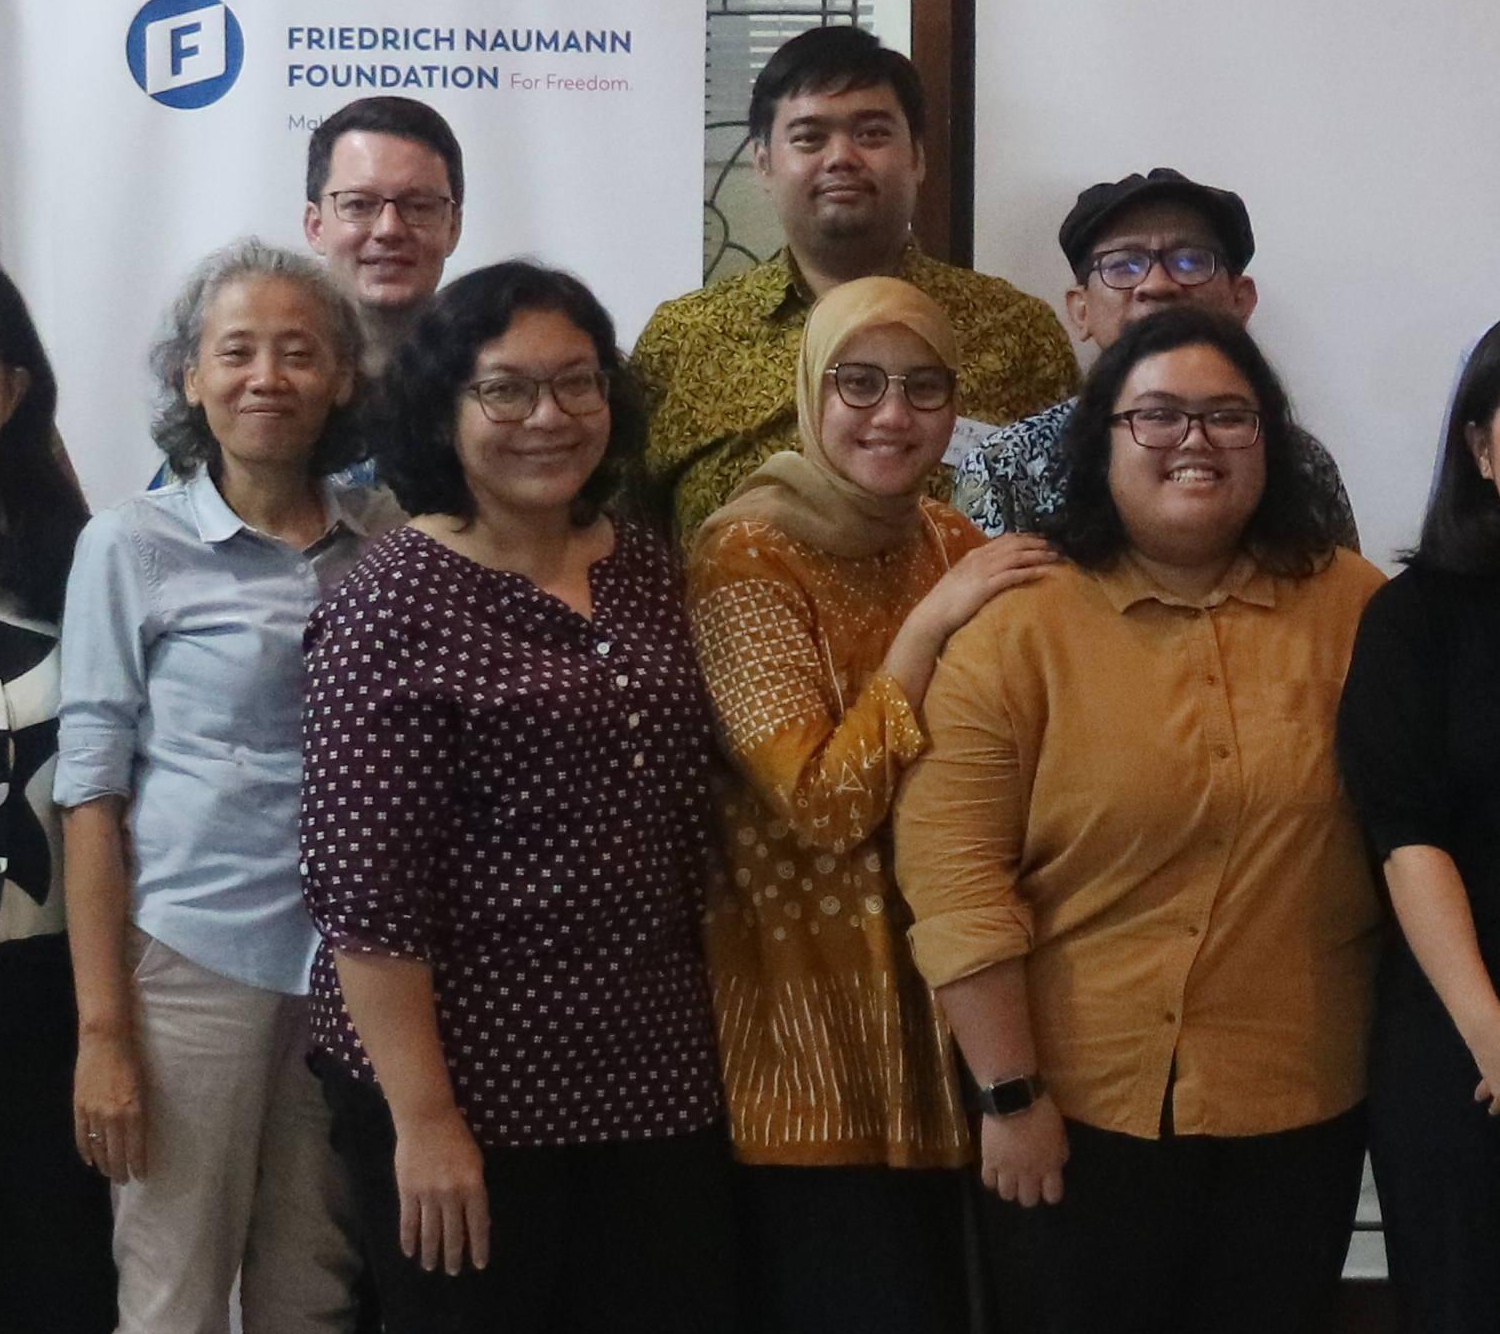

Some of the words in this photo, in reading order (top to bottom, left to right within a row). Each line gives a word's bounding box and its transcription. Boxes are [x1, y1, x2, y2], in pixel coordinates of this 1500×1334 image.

[288, 27, 455, 52] FRIEDRICH
[466, 29, 632, 54] NAUMANN
[288, 64, 499, 89] FOUNDATION
[511, 73, 541, 91] For
[547, 74, 634, 93] Freedom.
